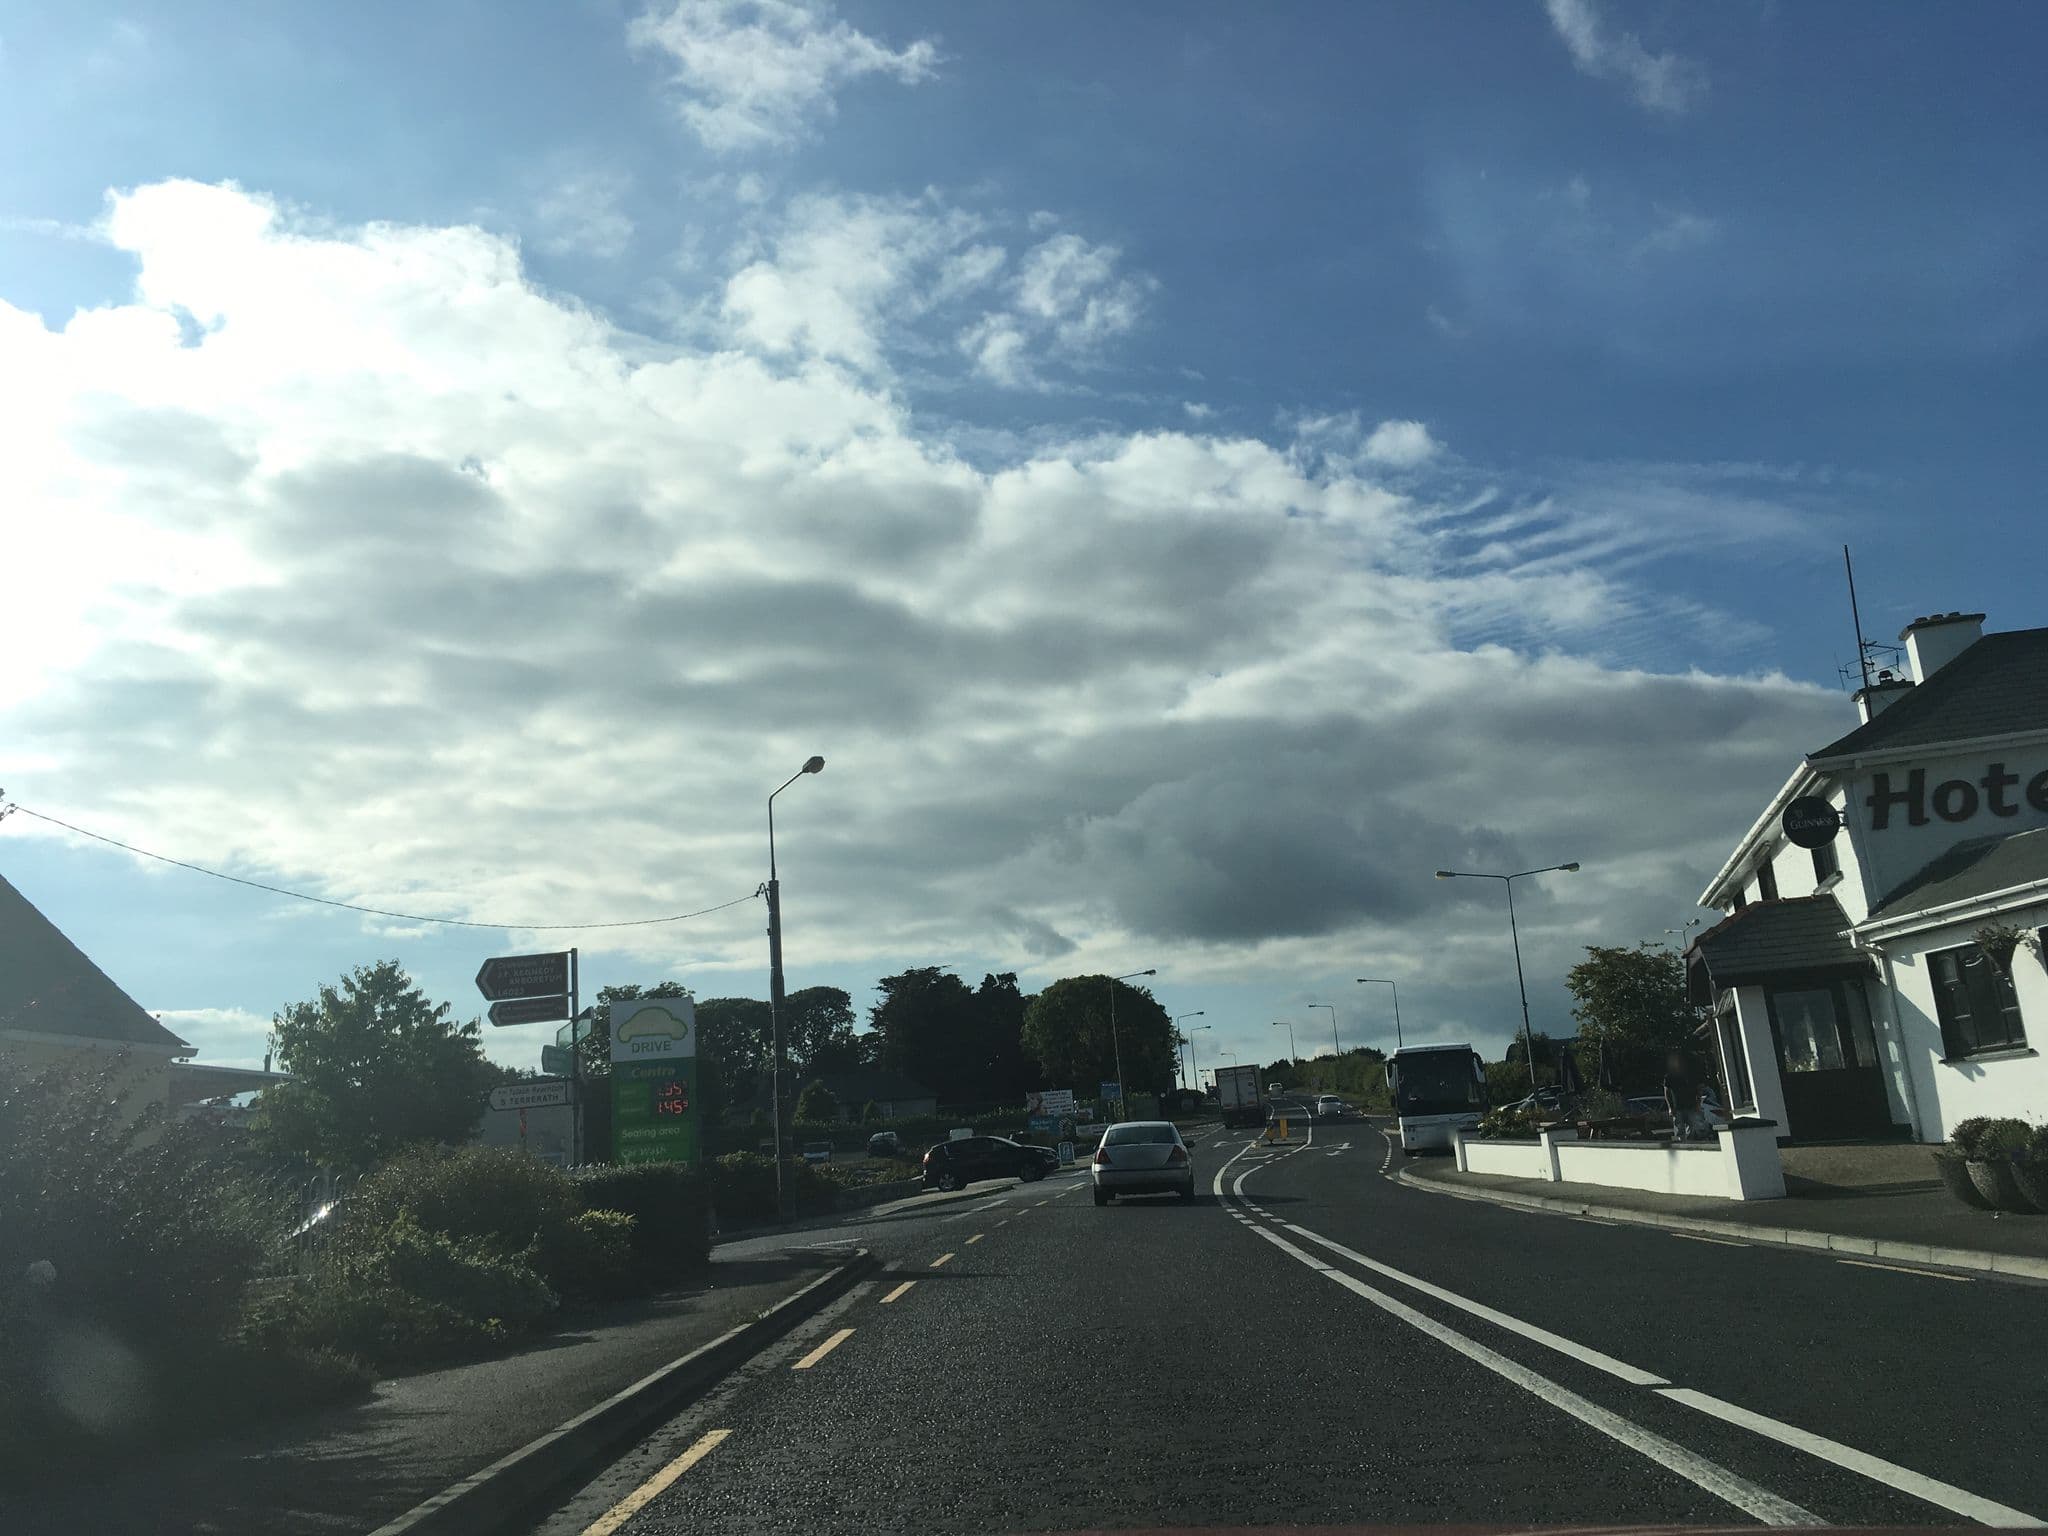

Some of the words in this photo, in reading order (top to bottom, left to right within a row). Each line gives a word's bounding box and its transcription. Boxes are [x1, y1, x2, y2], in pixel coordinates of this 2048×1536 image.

[632, 1040, 672, 1053] DRIVE
[622, 1128, 657, 1139] Seating
[659, 1127, 680, 1136] area
